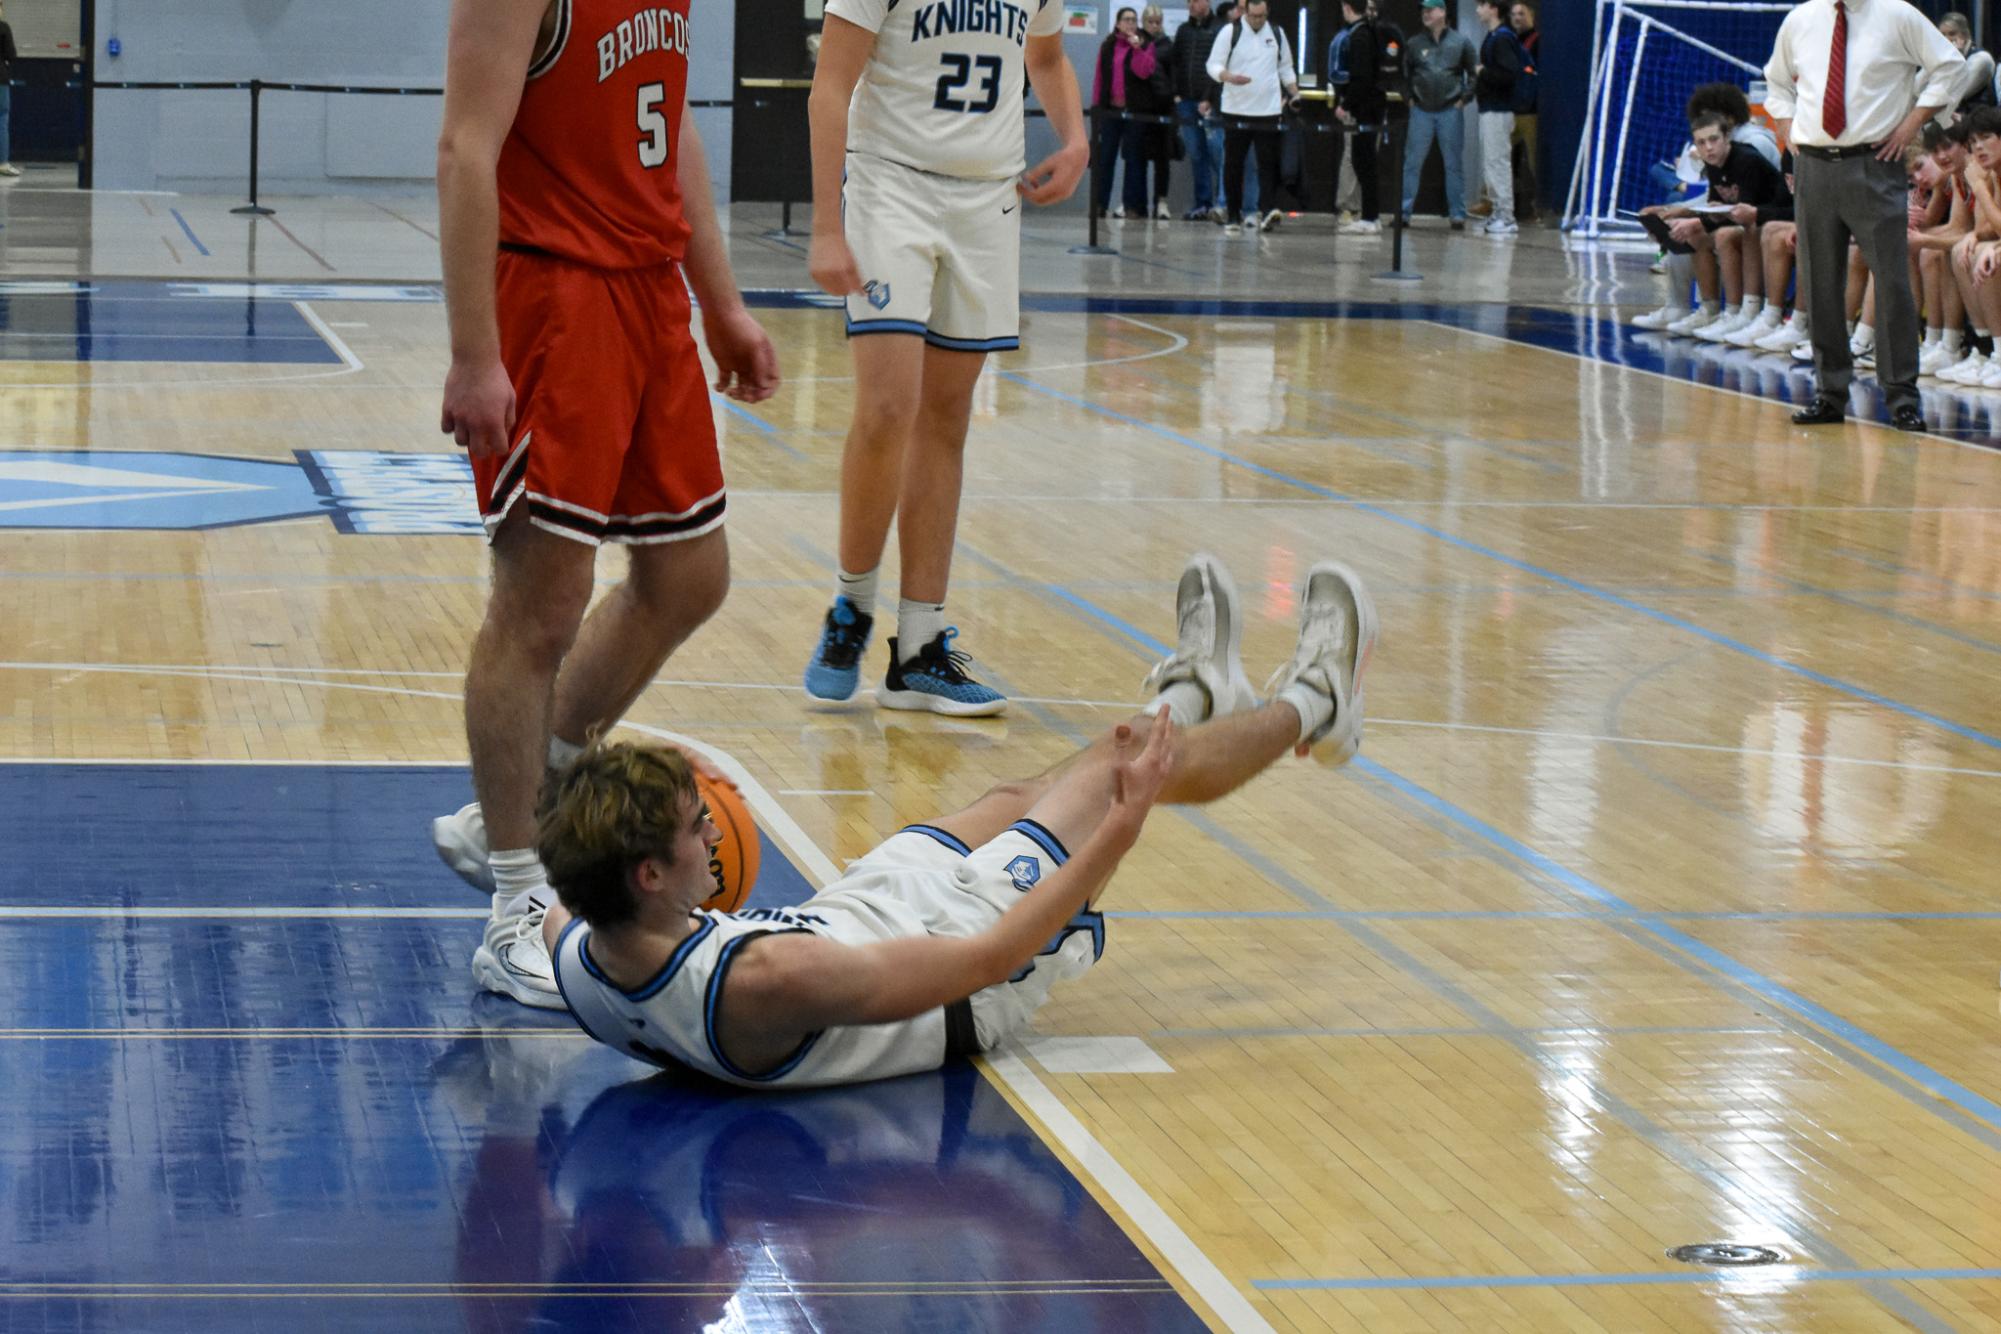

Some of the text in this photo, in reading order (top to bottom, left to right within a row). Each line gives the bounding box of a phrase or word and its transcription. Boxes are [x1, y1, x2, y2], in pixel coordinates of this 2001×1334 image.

[912, 0, 1027, 46] KNIGHTS
[934, 53, 1002, 113] 23
[637, 81, 668, 169] 5
